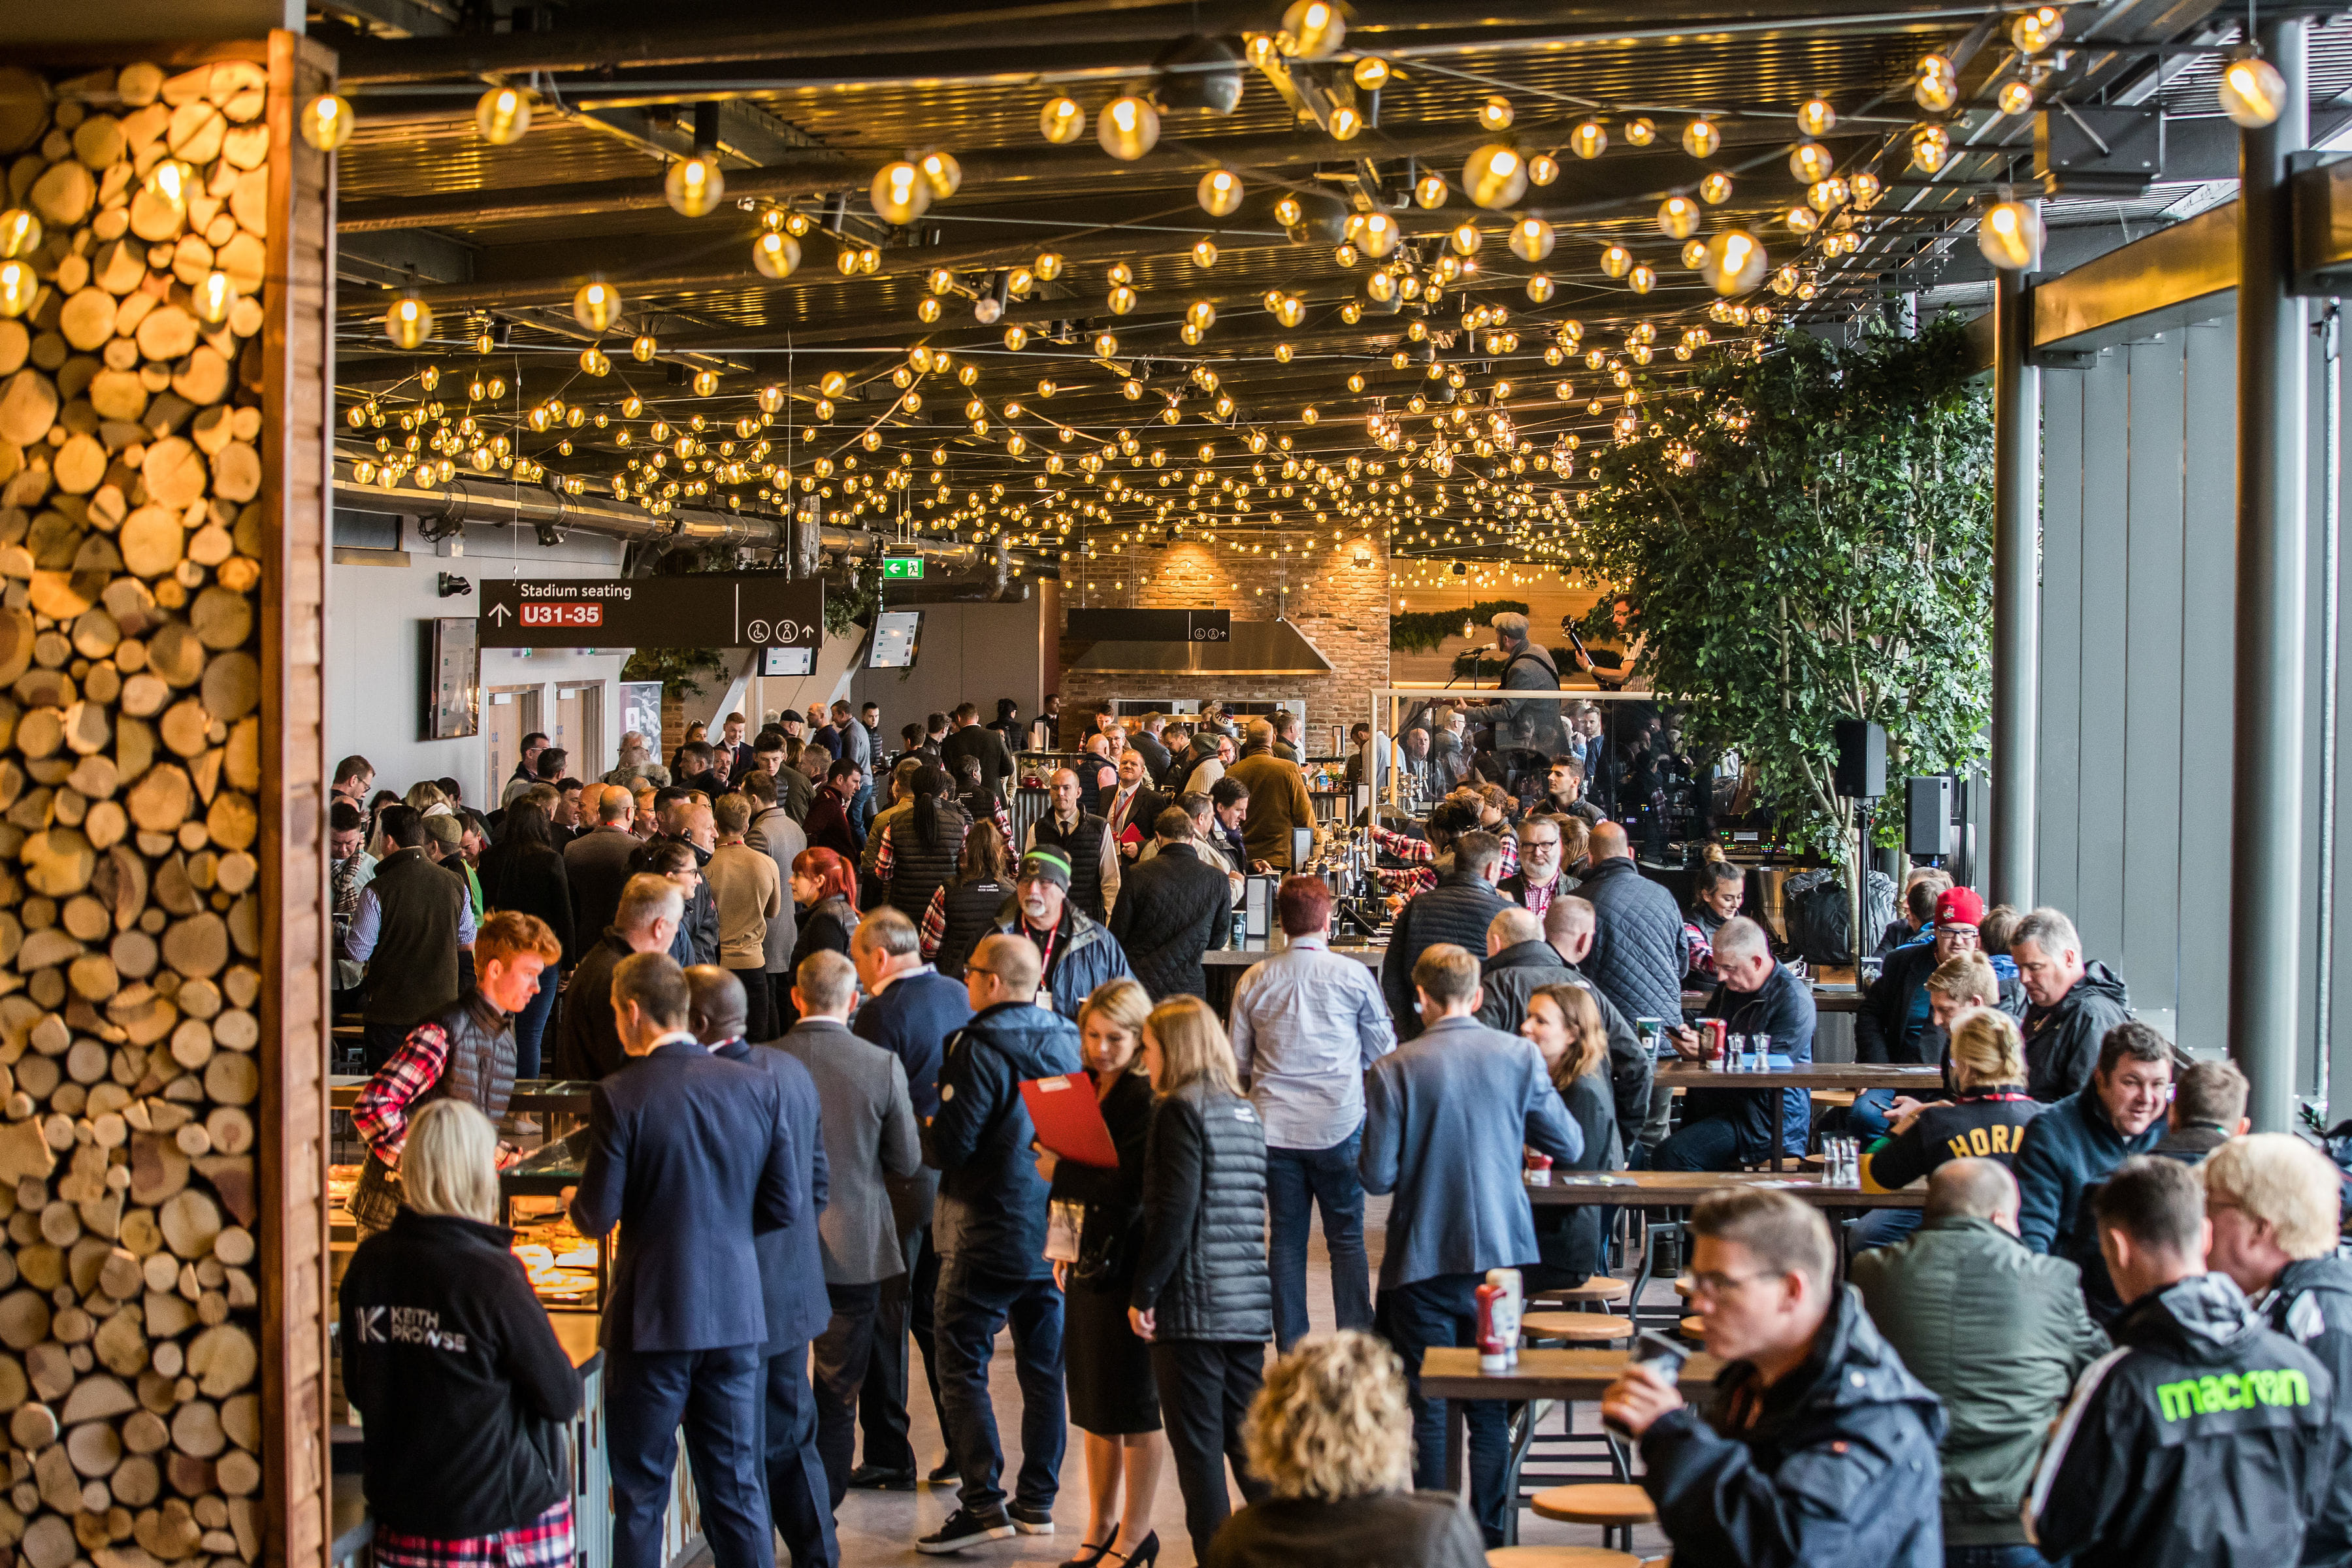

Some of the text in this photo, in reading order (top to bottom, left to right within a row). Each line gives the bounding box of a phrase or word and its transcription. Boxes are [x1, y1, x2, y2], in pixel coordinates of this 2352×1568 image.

[520, 583, 632, 600] Stadium seating
[524, 606, 599, 623] U31-35
[391, 1306, 439, 1328] KEITH
[391, 1324, 467, 1352] PROWSE
[2156, 1369, 2311, 1422] macron
